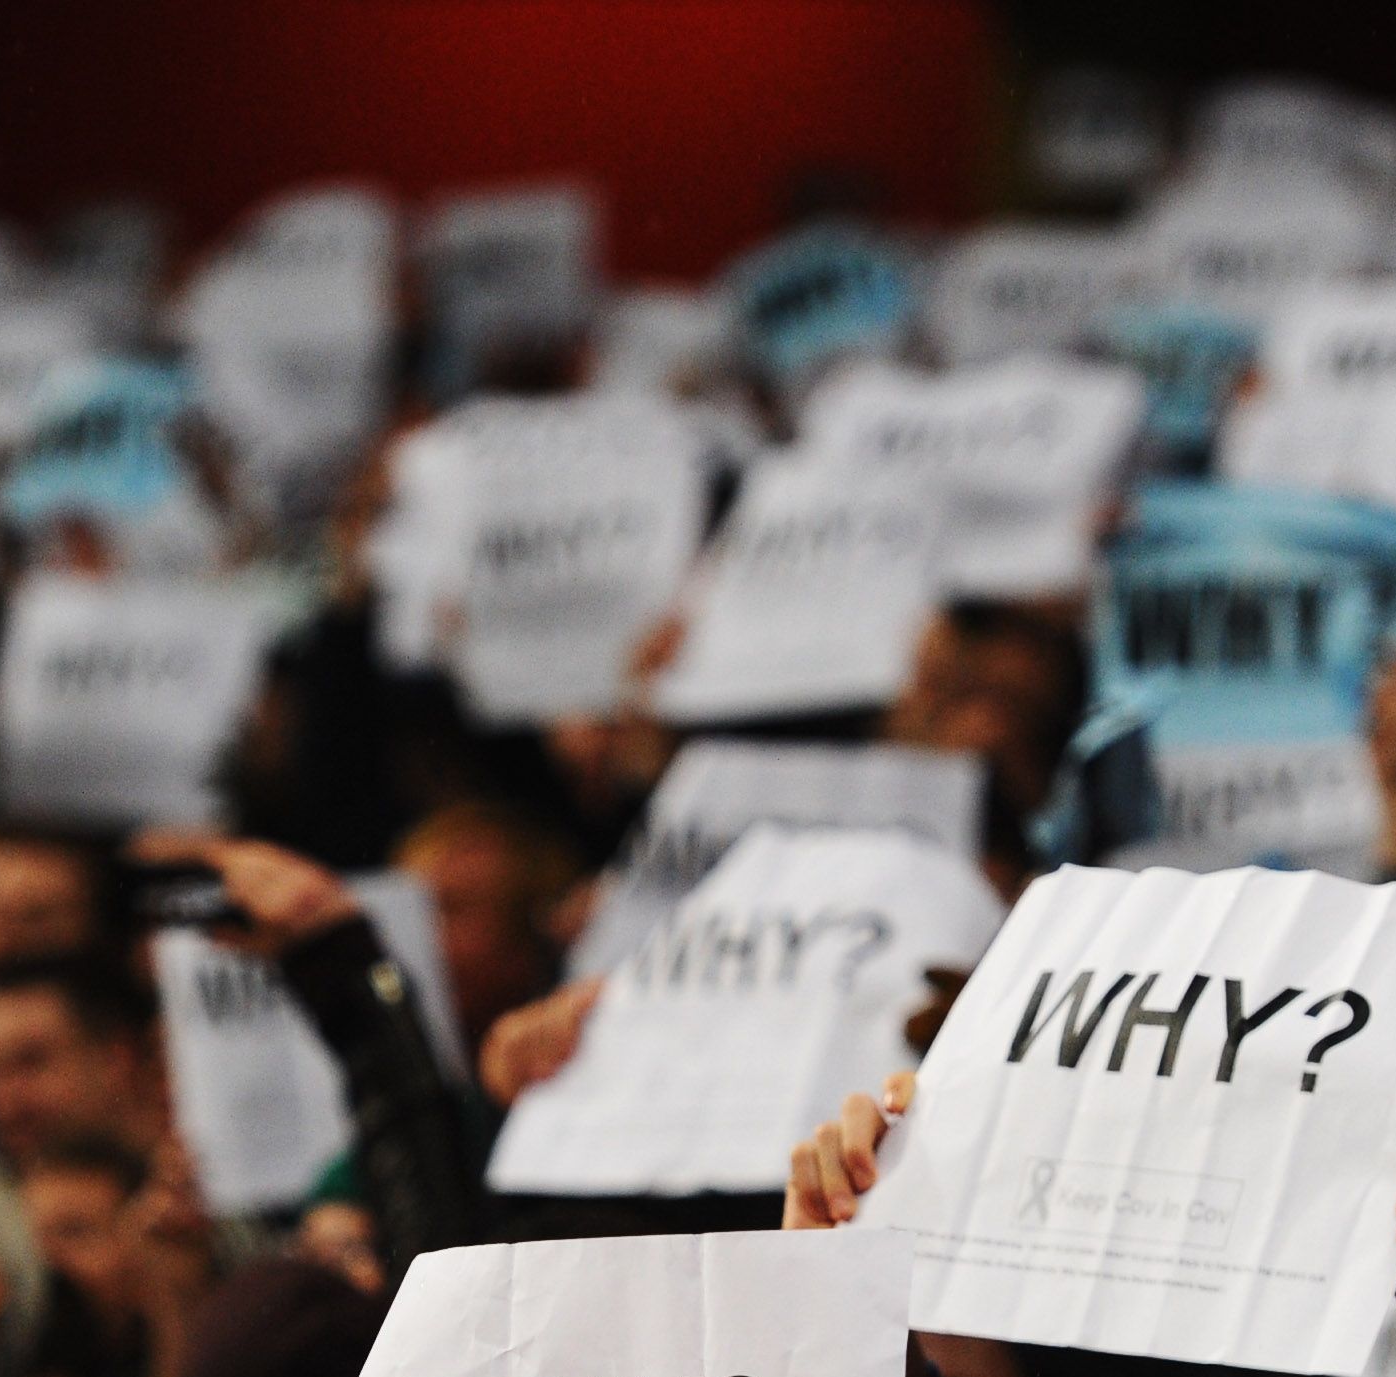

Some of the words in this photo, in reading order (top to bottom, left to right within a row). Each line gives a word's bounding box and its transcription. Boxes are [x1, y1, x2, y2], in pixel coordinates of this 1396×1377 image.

[627, 906, 893, 994] WHY?
[1006, 972, 1372, 1094] WHY?
[1187, 1200, 1231, 1224] Cov
